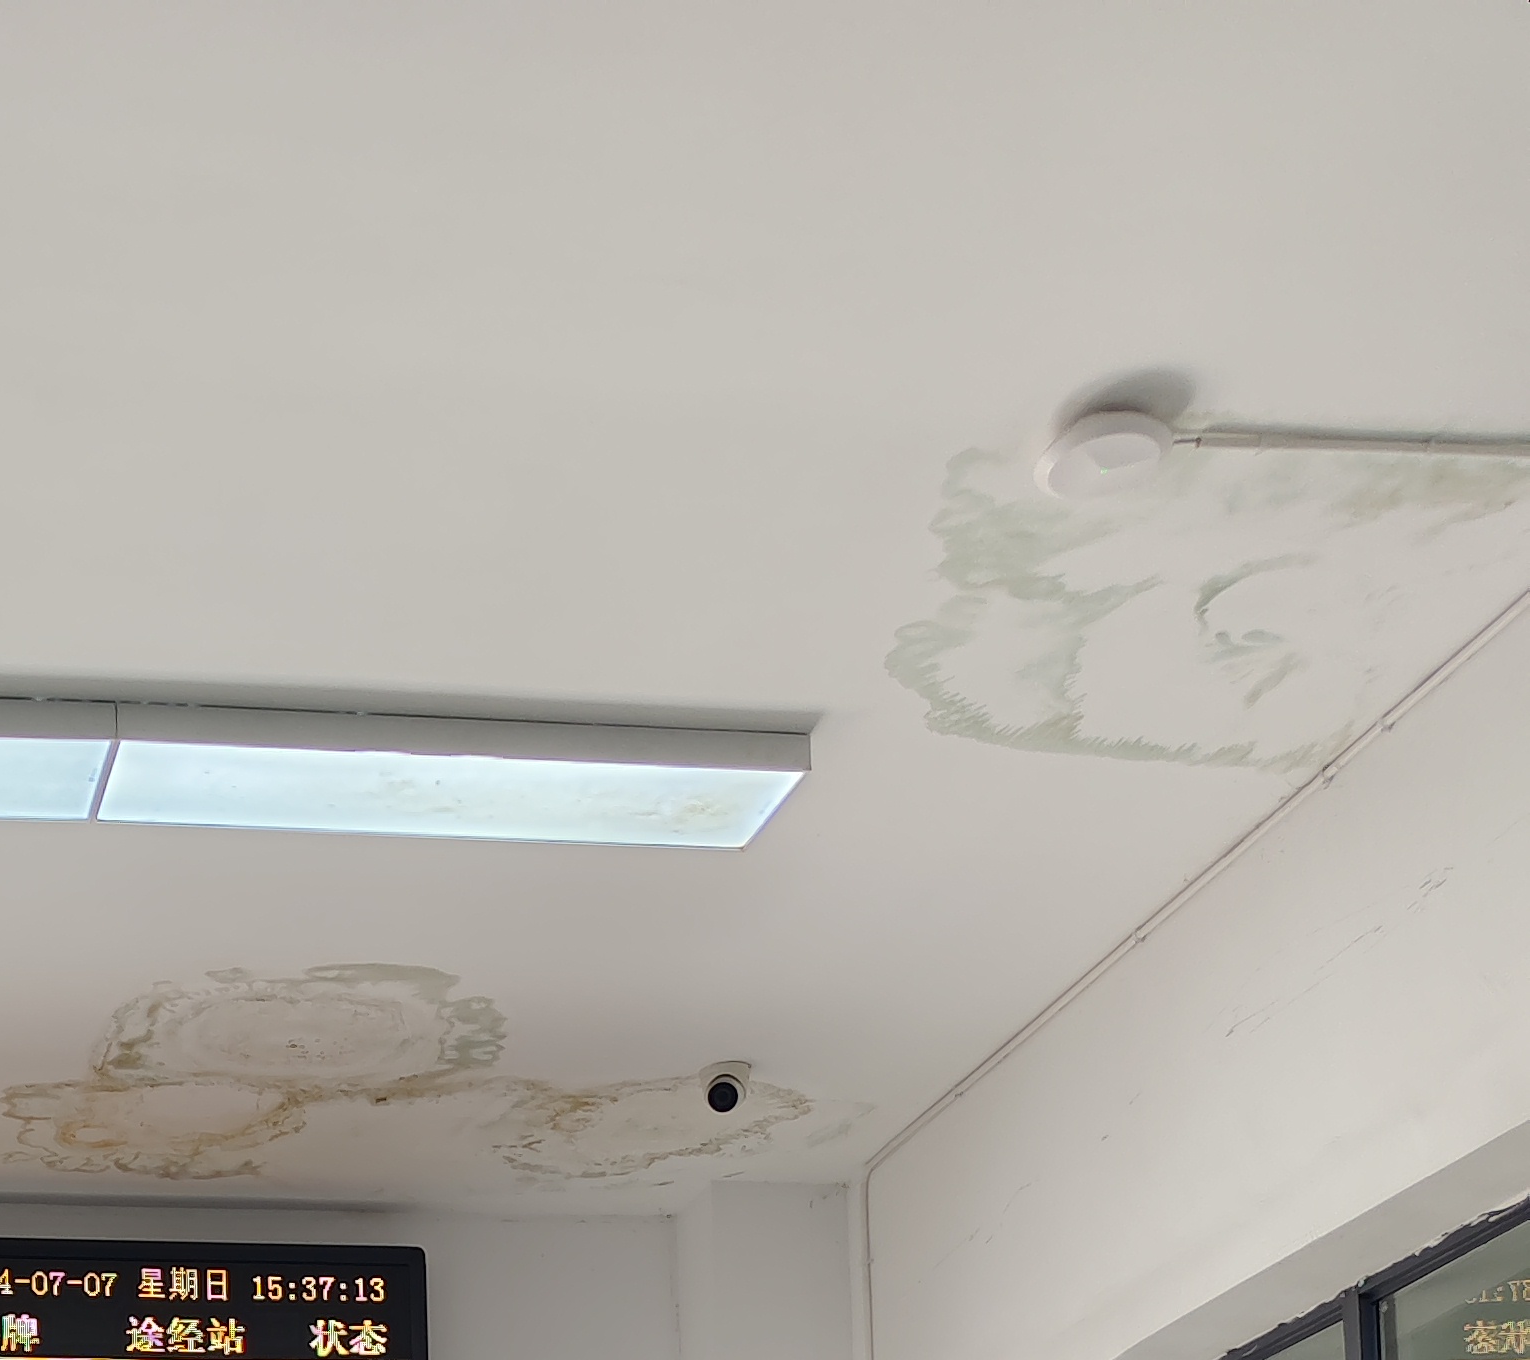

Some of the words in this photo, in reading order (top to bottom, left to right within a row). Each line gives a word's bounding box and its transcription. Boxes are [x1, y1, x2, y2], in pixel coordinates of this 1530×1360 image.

[138, 1267, 227, 1301] 星期日
[253, 1276, 384, 1301] 15:37:13
[126, 1317, 245, 1355] 途经站
[309, 1320, 387, 1356] 状态
